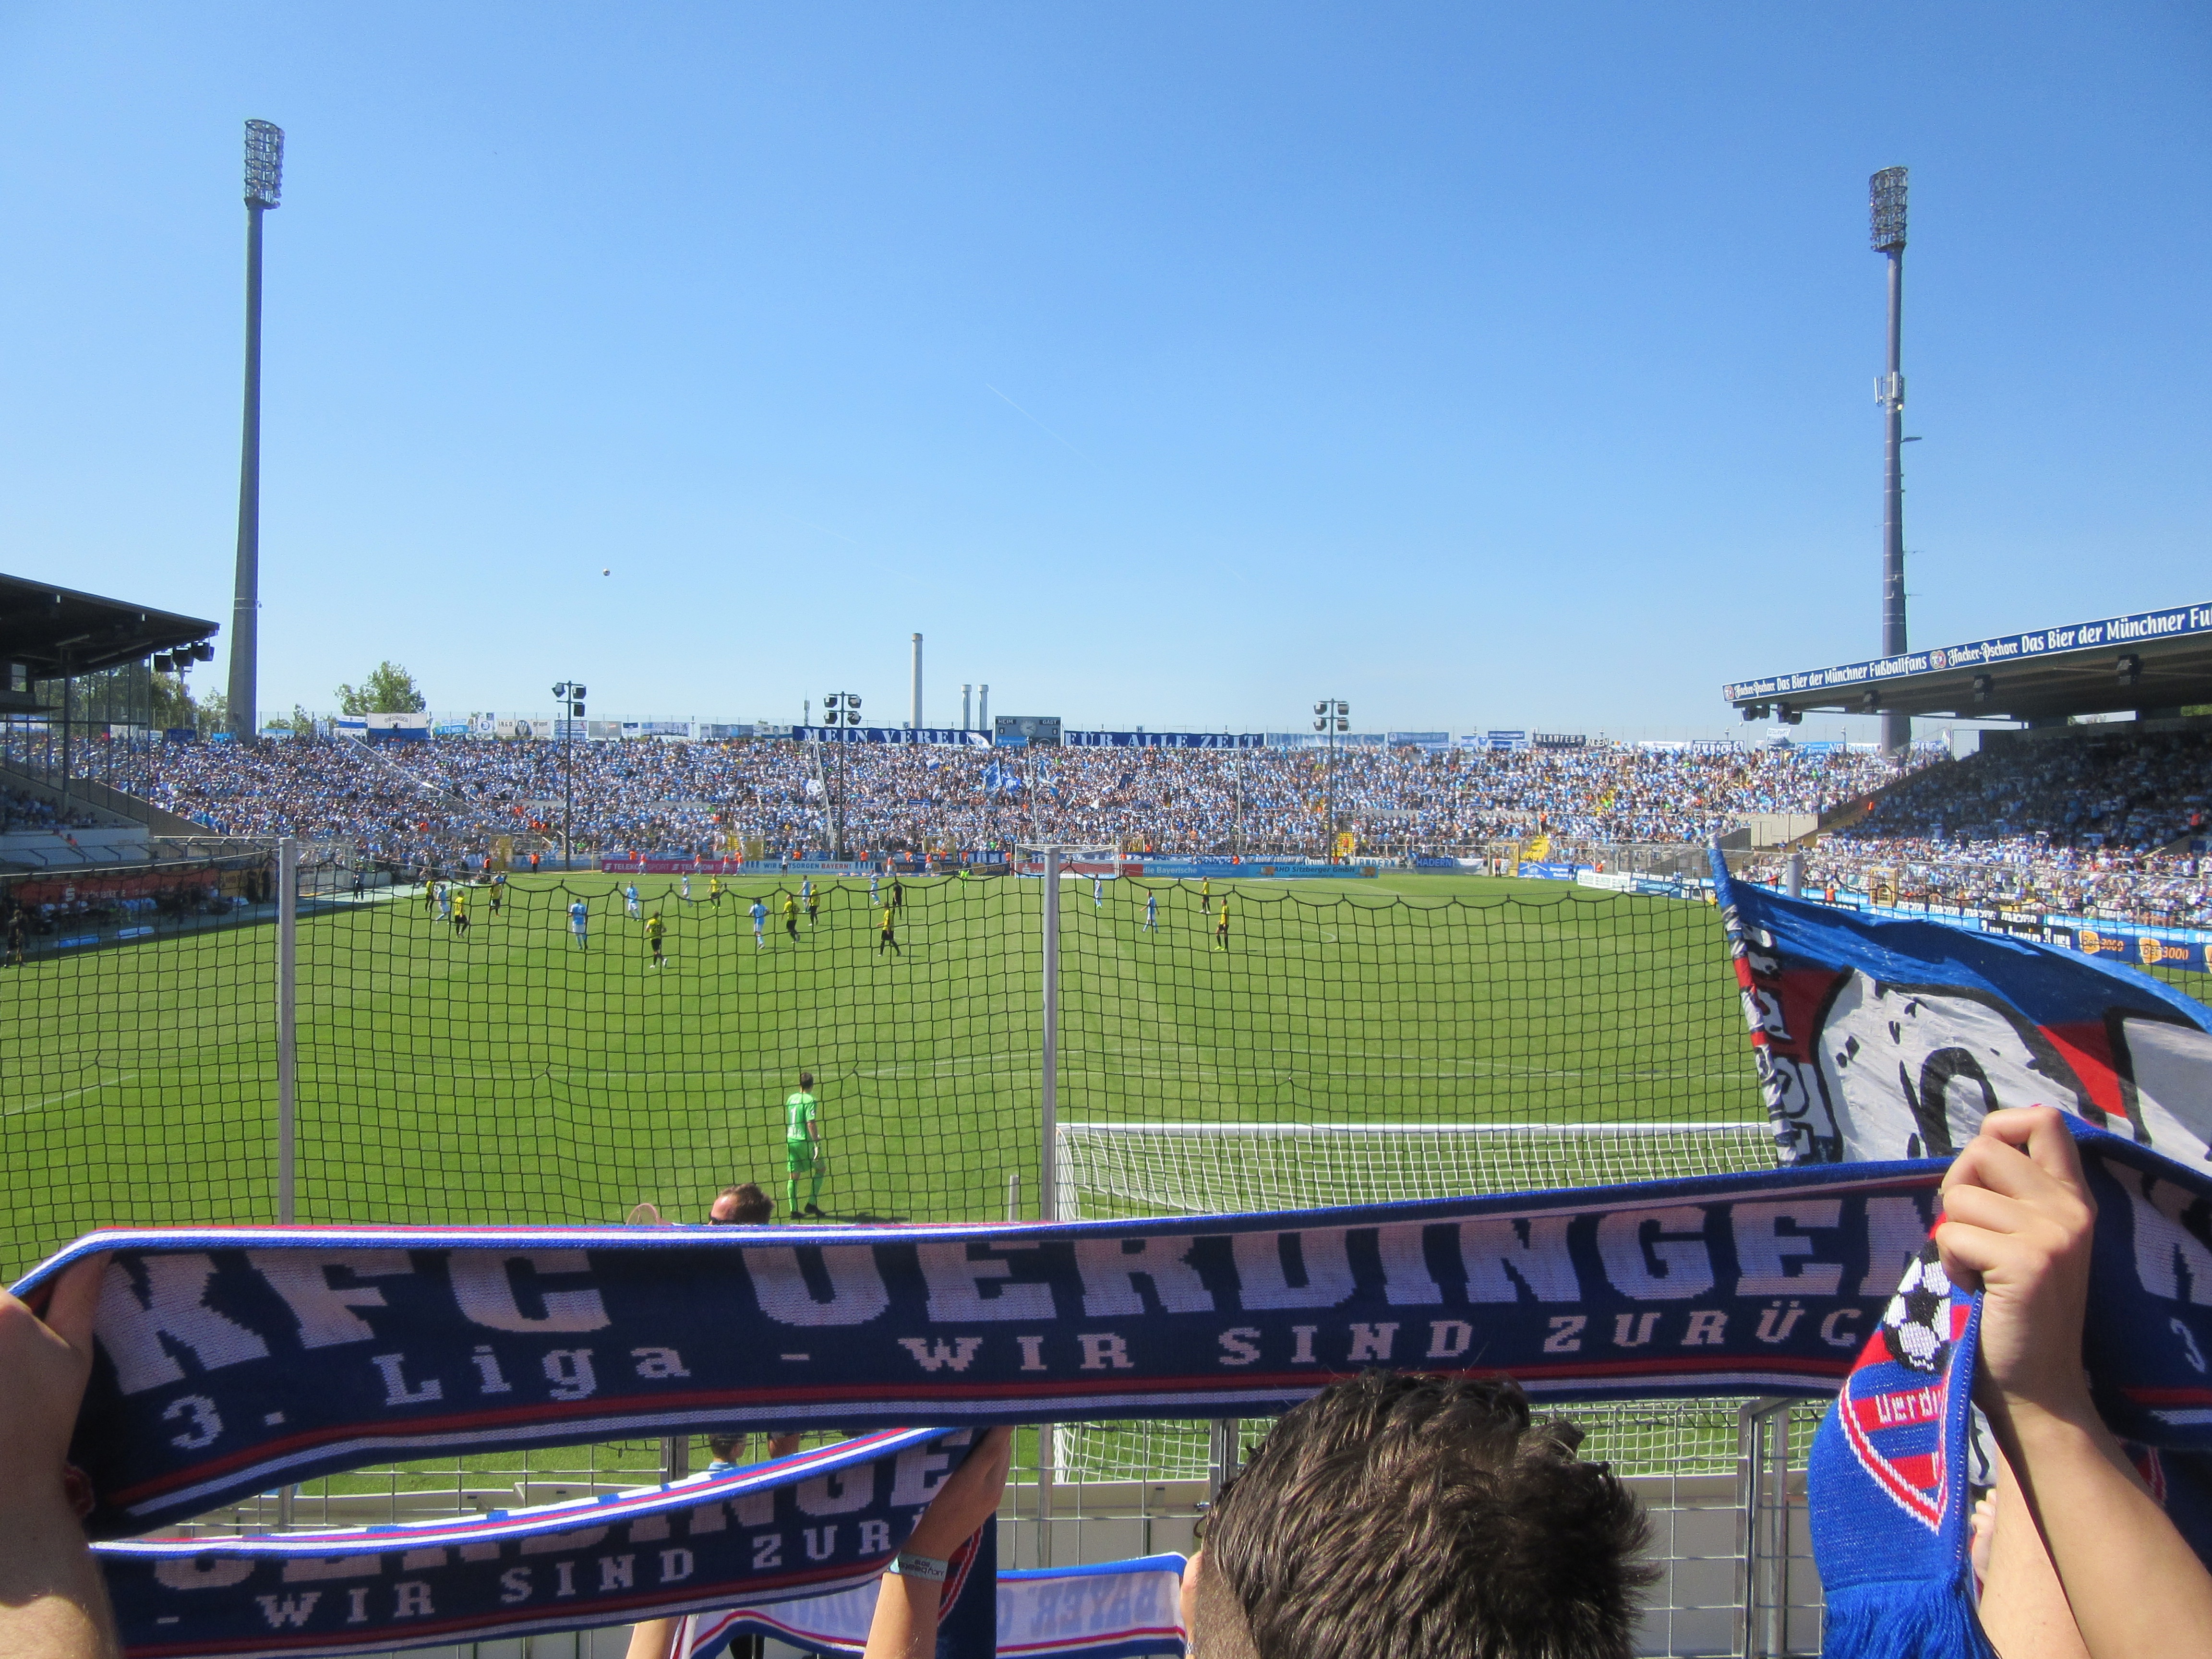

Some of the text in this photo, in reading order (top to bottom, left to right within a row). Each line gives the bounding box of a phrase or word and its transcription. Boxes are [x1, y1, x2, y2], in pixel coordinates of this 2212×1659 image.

[1948, 641, 2018, 667] Hacker-Pschorr
[2021, 633, 2044, 653] Das
[2048, 629, 2075, 649] Bier
[2078, 625, 2103, 646] der
[2106, 613, 2186, 641] Münchner
[1734, 656, 1927, 698] Hacker-Pschorr Das Bier der Münchner Fußballfans
[803, 728, 868, 743] MEIN
[1065, 732, 1258, 748] FÜR ALLE ZEIT
[1156, 866, 1197, 875] Bayerische
[1292, 866, 1331, 875] Sitzberger
[1896, 900, 1925, 912] macron
[1929, 903, 1960, 915] macron
[2001, 912, 2037, 924] macron
[2082, 935, 2125, 952] Bet 3000
[2143, 943, 2190, 960] Bet 3000
[93, 1249, 612, 1395] KFC
[162, 1394, 286, 1449] 3.
[372, 1345, 691, 1406] Liga
[898, 1332, 1134, 1372] WIR
[1218, 1319, 1473, 1365] SIND
[1543, 1300, 1861, 1353] ZURÜC
[1875, 1387, 1942, 1424] Uerdi
[256, 1581, 434, 1628] WIR
[500, 1548, 693, 1604] SIND
[753, 1507, 924, 1570] ZUR
